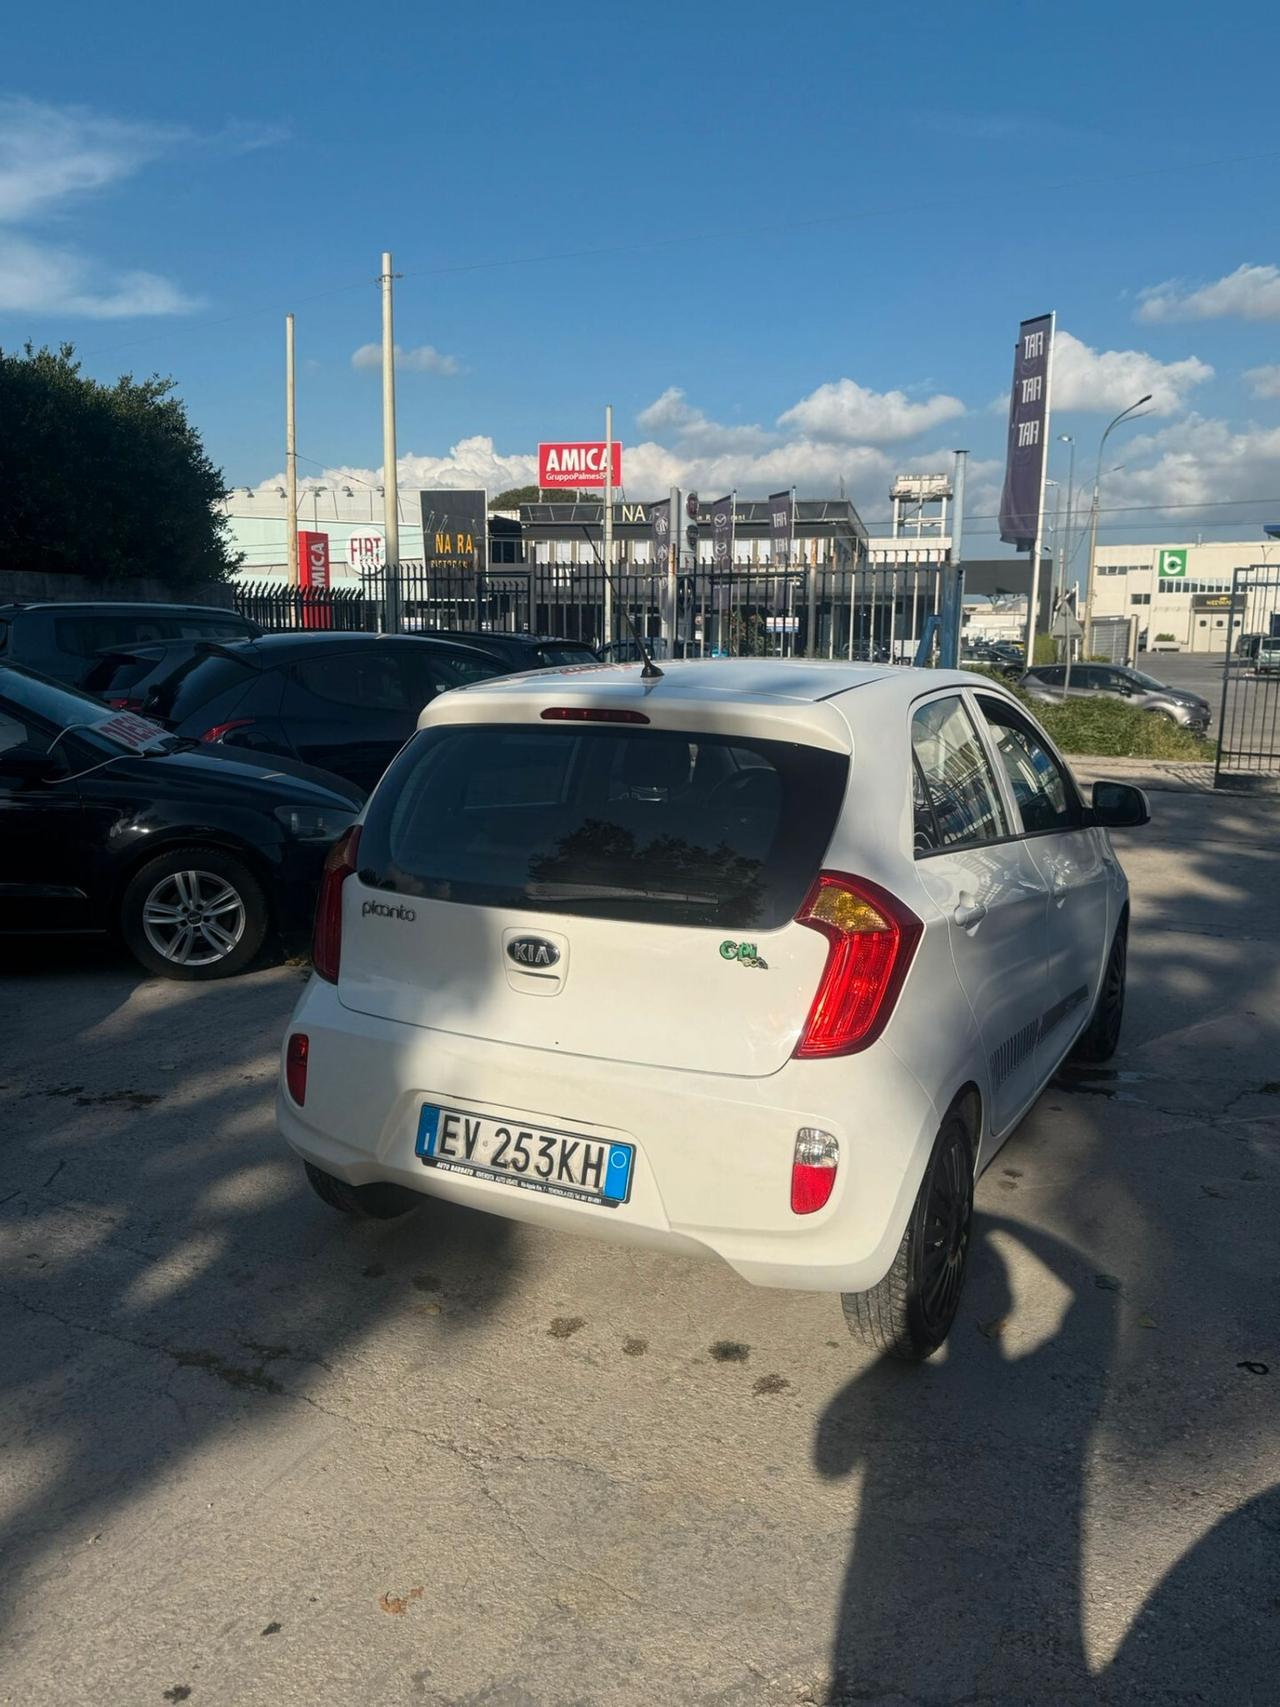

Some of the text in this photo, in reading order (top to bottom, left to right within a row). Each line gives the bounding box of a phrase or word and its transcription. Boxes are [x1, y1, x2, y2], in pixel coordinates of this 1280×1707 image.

[546, 448, 613, 471] AMICA
[622, 505, 646, 521] NA
[351, 537, 381, 565] FIAT
[435, 534, 473, 554] NA RA
[311, 543, 325, 589] MICA
[362, 899, 415, 922] picanto
[514, 942, 550, 964] KIA
[439, 1114, 605, 1189] EV 253KH
